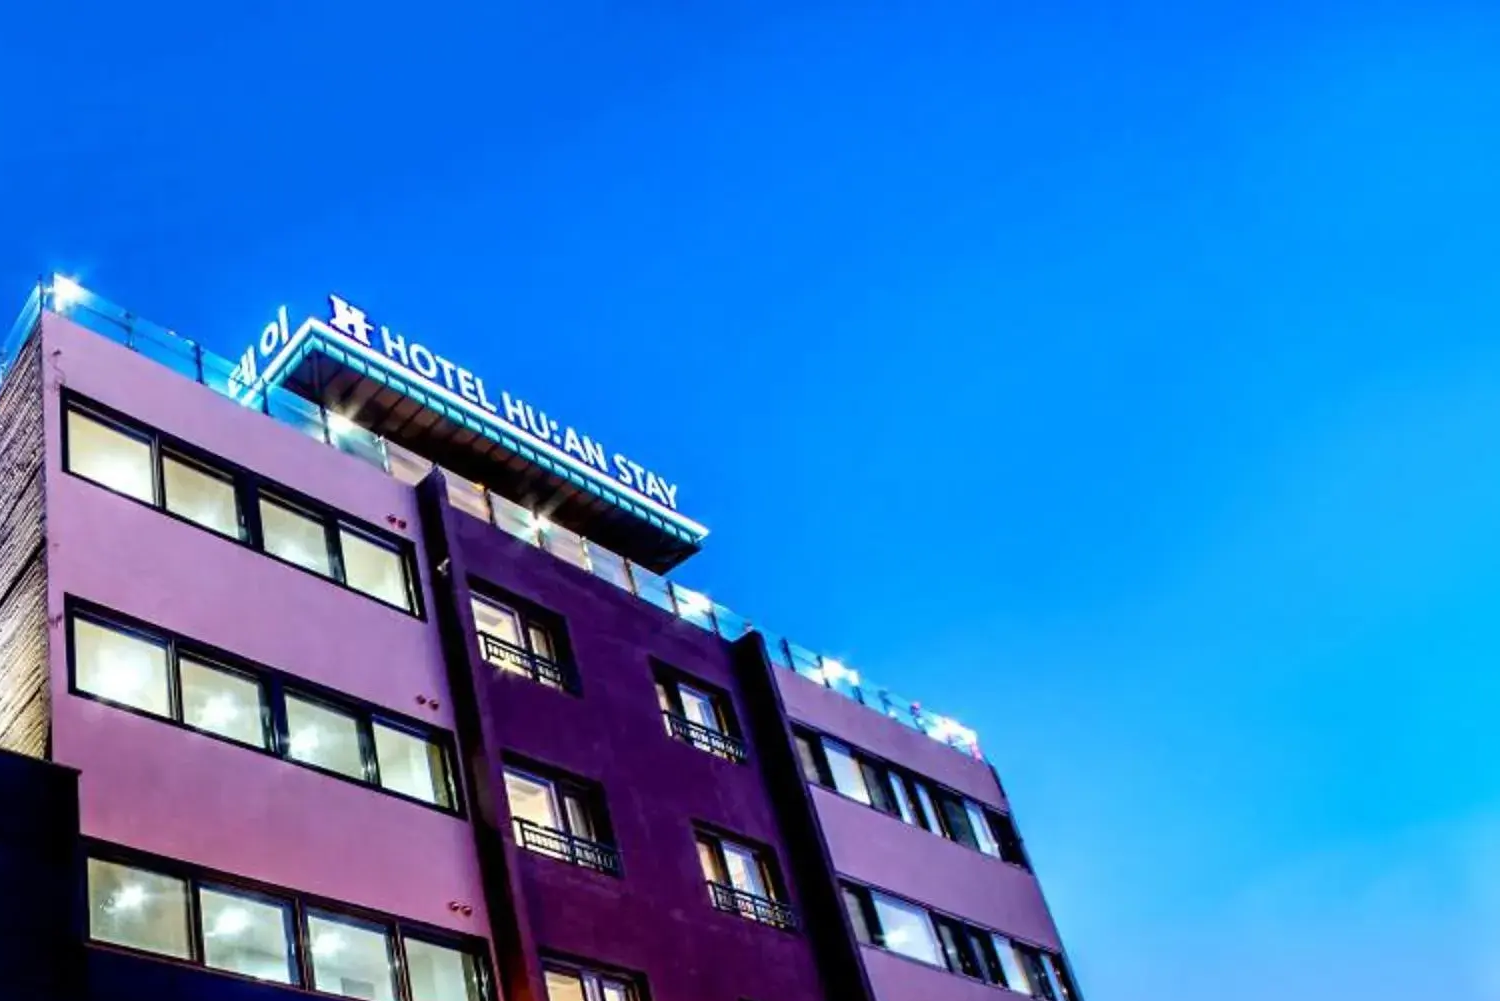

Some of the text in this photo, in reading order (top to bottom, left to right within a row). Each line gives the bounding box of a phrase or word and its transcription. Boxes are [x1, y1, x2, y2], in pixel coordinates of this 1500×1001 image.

[380, 325, 498, 413] HOTEL
[502, 390, 609, 473] HU:AN
[613, 452, 678, 510] STAY
